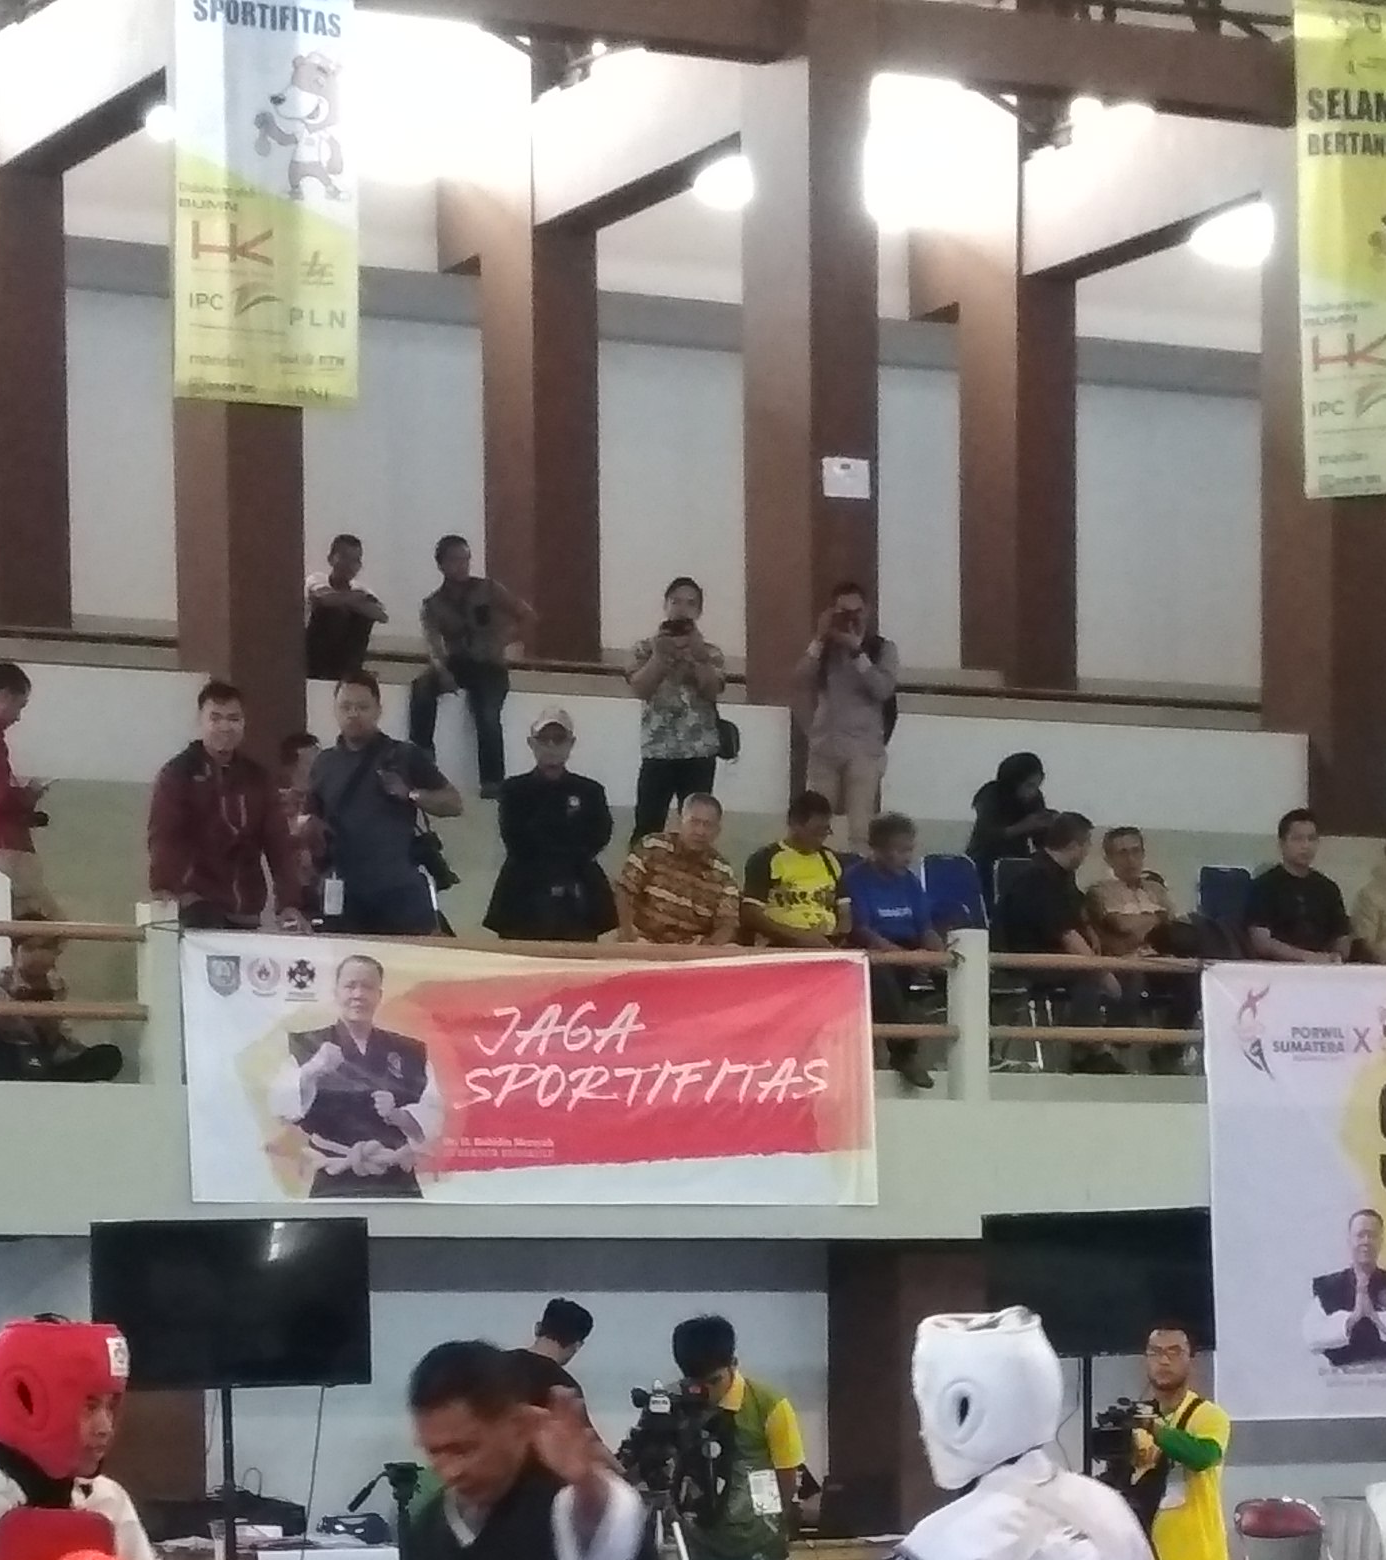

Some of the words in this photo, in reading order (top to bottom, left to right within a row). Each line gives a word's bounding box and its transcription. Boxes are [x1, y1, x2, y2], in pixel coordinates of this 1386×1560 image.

[193, 0, 341, 37] SPORTIFITAS
[189, 293, 224, 310] IPC
[289, 307, 346, 328] PLN
[1312, 400, 1345, 417] IPC
[474, 1001, 645, 1056] JAGA
[1291, 1027, 1344, 1039] PORWIL
[1272, 1041, 1344, 1053] SUMATERA
[454, 1057, 828, 1111] SPORTIFITAS
